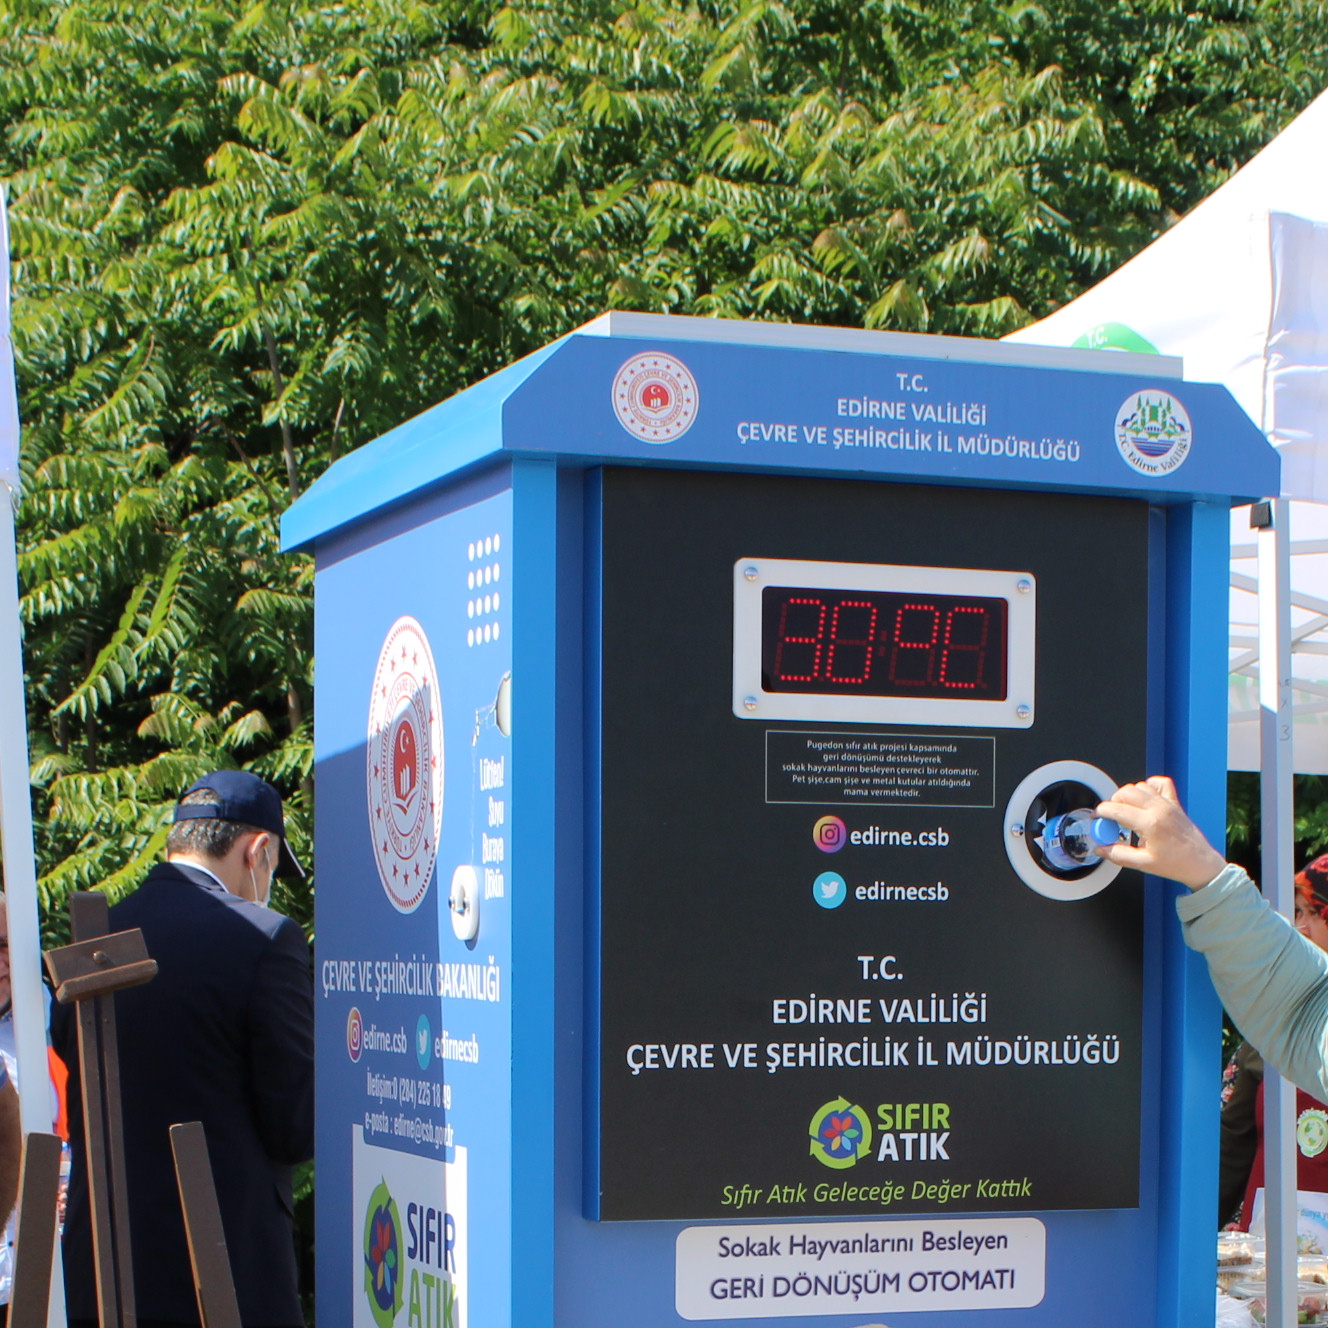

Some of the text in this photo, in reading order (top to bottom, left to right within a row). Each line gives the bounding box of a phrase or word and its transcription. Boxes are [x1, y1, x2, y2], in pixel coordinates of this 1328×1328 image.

[895, 372, 929, 393] T.C.
[836, 395, 988, 427] EDİRNE VALİLİĞİ
[736, 421, 1081, 462] ÇEVRE VE ŞEHİRCİLİK İL MÜDÜRLÜĞÜ
[806, 740, 844, 751] Pugedon
[862, 741, 878, 751] atık
[879, 742, 908, 754] projesi
[909, 743, 958, 754] kapsamında
[823, 752, 942, 765] geri dönüşümü destekleyerek
[782, 763, 980, 776] sokak hayvanlarını besleyen çevreci bir otomattır.
[792, 775, 806, 784] Pet
[844, 776, 860, 787] şişe
[861, 777, 871, 785] ve
[872, 776, 896, 785] metal
[897, 777, 927, 787] kutular
[928, 777, 971, 788] atıldığında
[843, 787, 921, 798] mama vermektedir.
[850, 825, 950, 847] edirne.csb
[855, 881, 950, 901] edirnecsb
[322, 954, 501, 1003] ÇEVRE VE ŞEHİRCİLİK BAKANLIĞI
[857, 955, 904, 981] T.C.
[772, 992, 988, 1025] EDİRNE VALİLİĞİ
[363, 1024, 480, 1064] edirne.csb edirnecsb
[625, 1033, 1120, 1076] ÇEVRE VE ŞEHİRCİLİK İL MÜDÜRLÜĞÜ
[876, 1102, 951, 1131] SIFIR
[877, 1132, 951, 1161] ATIK
[721, 1176, 1032, 1209] Sıfır Atık Geleceğe Değer Kattık
[407, 1201, 457, 1274] SIFIR
[718, 1230, 1008, 1261] Sokak Hayvanlarını Besleyen
[710, 1268, 1015, 1302] GERİ DÖNÜŞÜM OTOMATI
